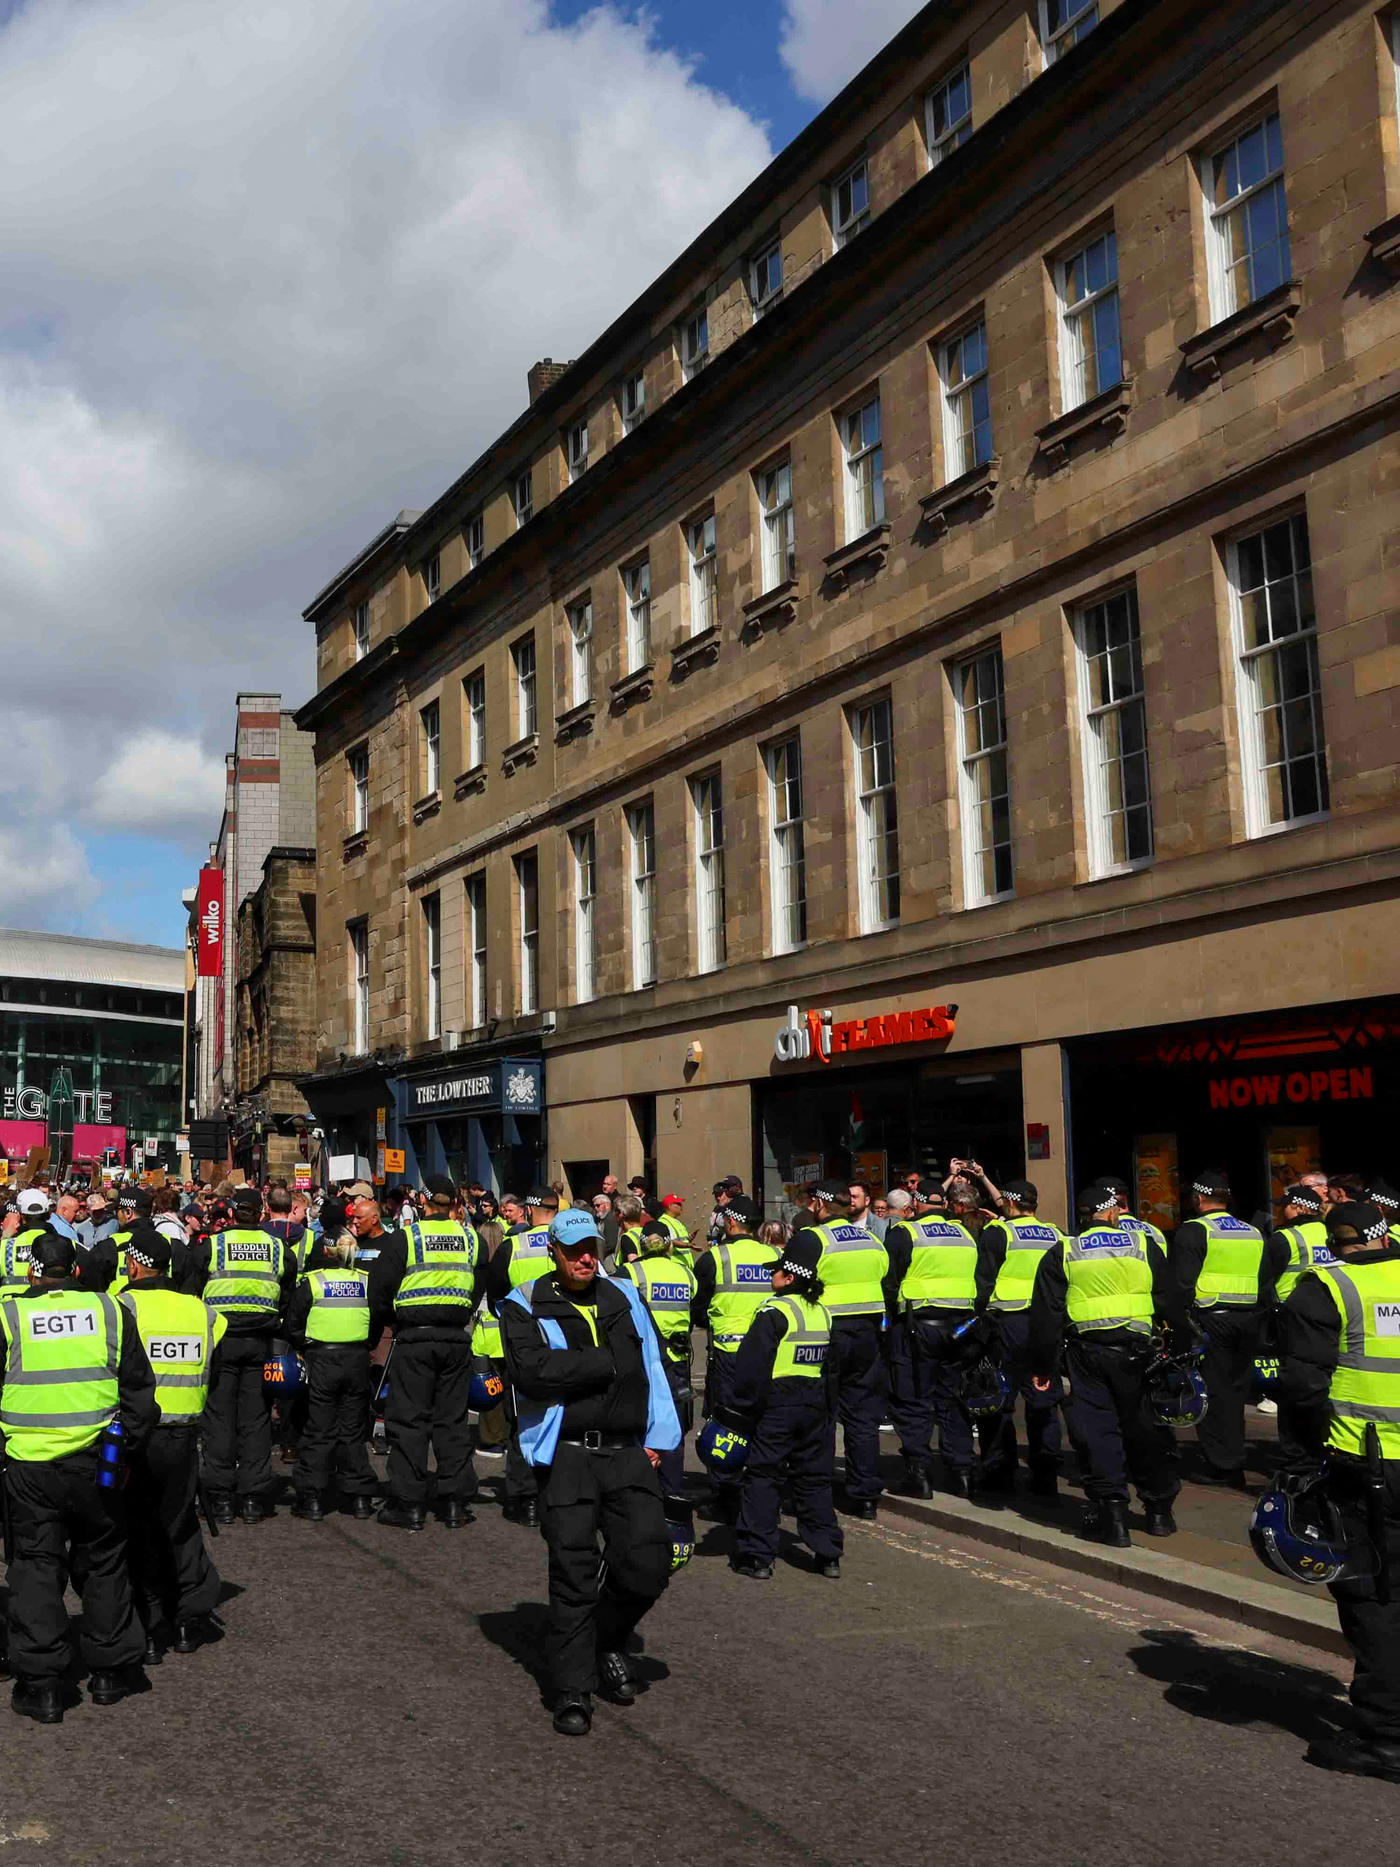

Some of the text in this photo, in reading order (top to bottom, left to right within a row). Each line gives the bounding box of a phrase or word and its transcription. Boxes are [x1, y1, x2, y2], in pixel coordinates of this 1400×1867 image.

[202, 900, 220, 945] wilko
[831, 1004, 958, 1053] FLAMES
[416, 1076, 492, 1104] THE LOWTHER
[1209, 1066, 1373, 1109] NOW OPEN
[4, 1086, 15, 1117] THE
[16, 1084, 112, 1125] GTE
[566, 1217, 589, 1227] POLICE
[924, 1225, 960, 1237] POLICE
[1018, 1229, 1053, 1241] POLICE
[529, 1235, 549, 1246] POL
[1081, 1236, 1132, 1249] POLICE
[230, 1243, 268, 1251] HEDDLU
[231, 1252, 269, 1261] POLICE
[1314, 1252, 1335, 1262] POL
[331, 1289, 360, 1297] POLICE
[652, 1286, 689, 1298] POLICE
[32, 1313, 95, 1335] EGT 1
[150, 1342, 202, 1358] EGT 1
[796, 1348, 826, 1362] POLIC
[264, 1370, 285, 1382] WO
[1261, 1367, 1278, 1378] LA
[715, 1434, 734, 1452] LA
